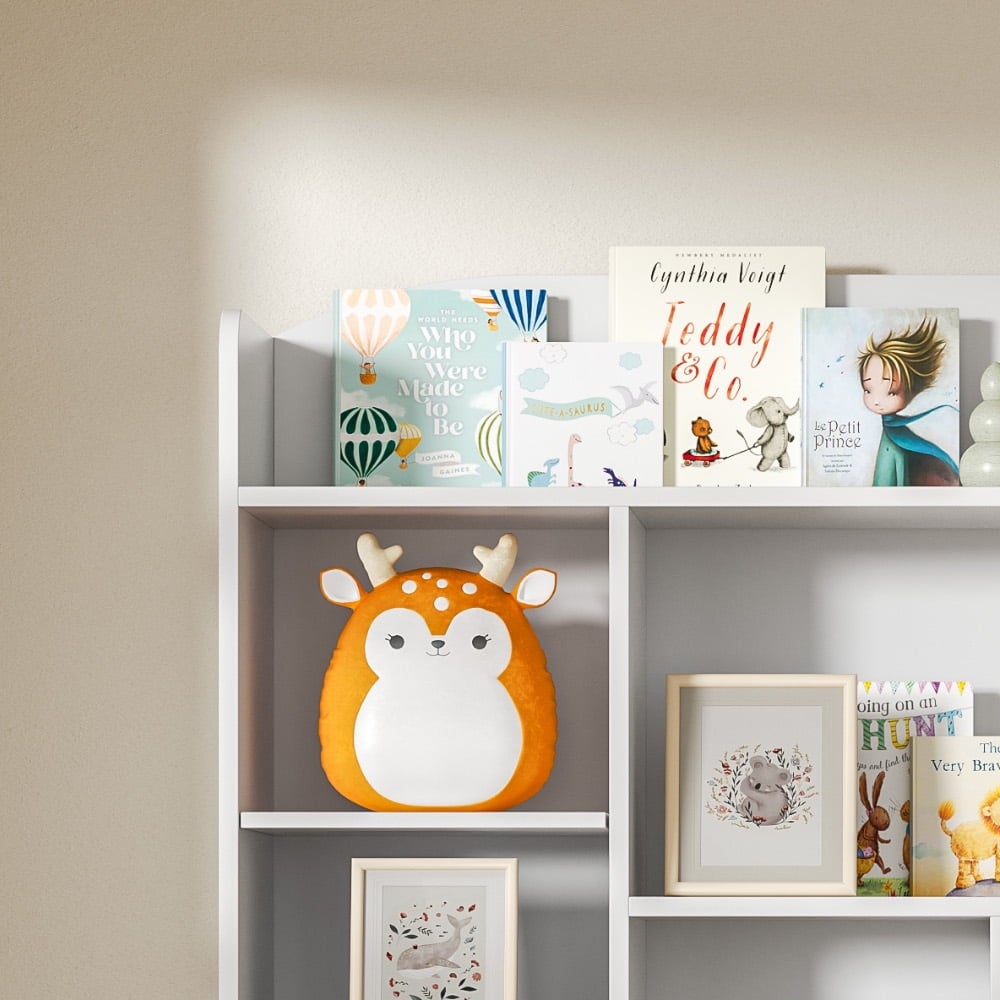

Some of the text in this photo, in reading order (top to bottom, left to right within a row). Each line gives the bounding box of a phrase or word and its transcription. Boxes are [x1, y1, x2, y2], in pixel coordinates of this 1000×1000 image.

[650, 261, 787, 294] Cynthia Voigt
[420, 326, 477, 351] Who
[661, 301, 775, 369] Teddy
[407, 342, 452, 360] You
[424, 362, 488, 380] Were
[670, 351, 748, 402] & Co.
[397, 379, 465, 404] Made
[425, 400, 449, 417] to
[433, 418, 465, 436] Be
[814, 419, 861, 437] Le Petit
[813, 434, 862, 451] Prince
[421, 452, 456, 463] JOANNA
[439, 465, 471, 476] GAINES
[857, 697, 938, 717] oing on an
[861, 708, 963, 750] HUNT
[931, 759, 965, 777] Very
